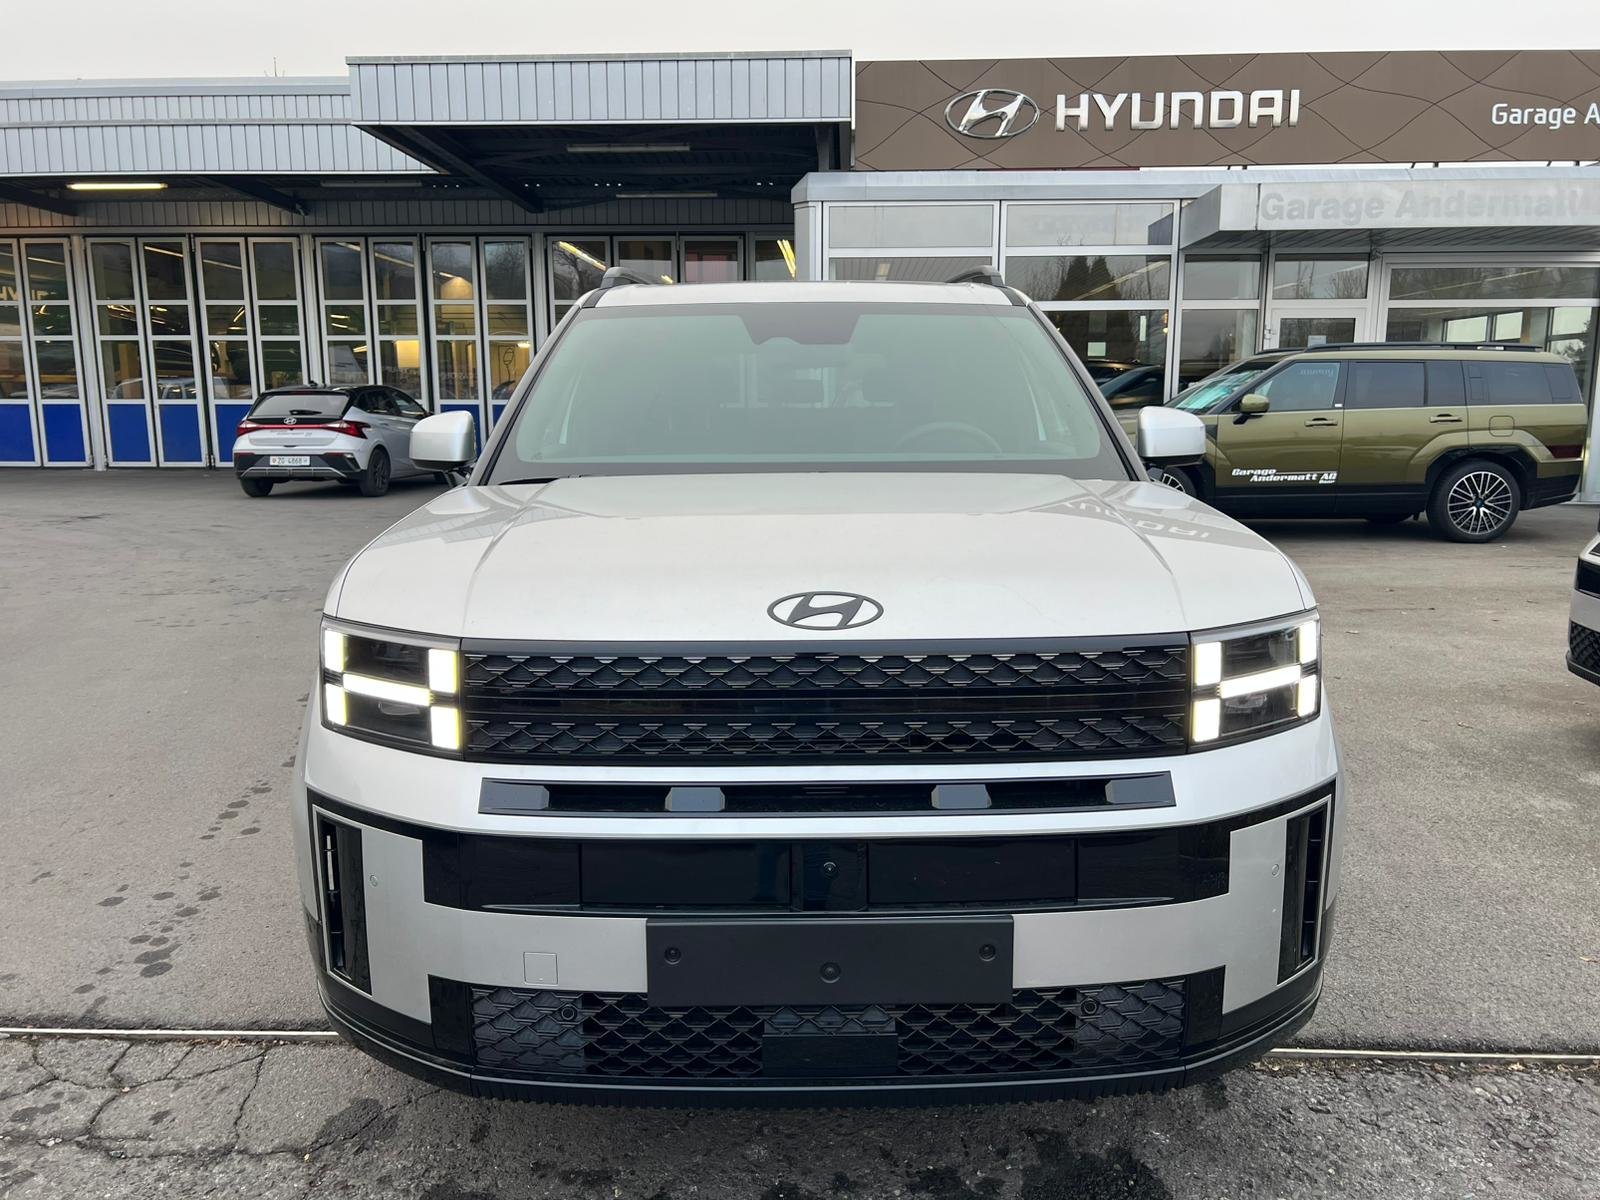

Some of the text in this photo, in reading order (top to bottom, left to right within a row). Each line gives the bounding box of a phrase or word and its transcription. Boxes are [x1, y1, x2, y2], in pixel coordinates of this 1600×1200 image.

[1055, 89, 1300, 131] HYUNDAI
[1491, 103, 1577, 130] Garage
[1260, 192, 1385, 225] Garage
